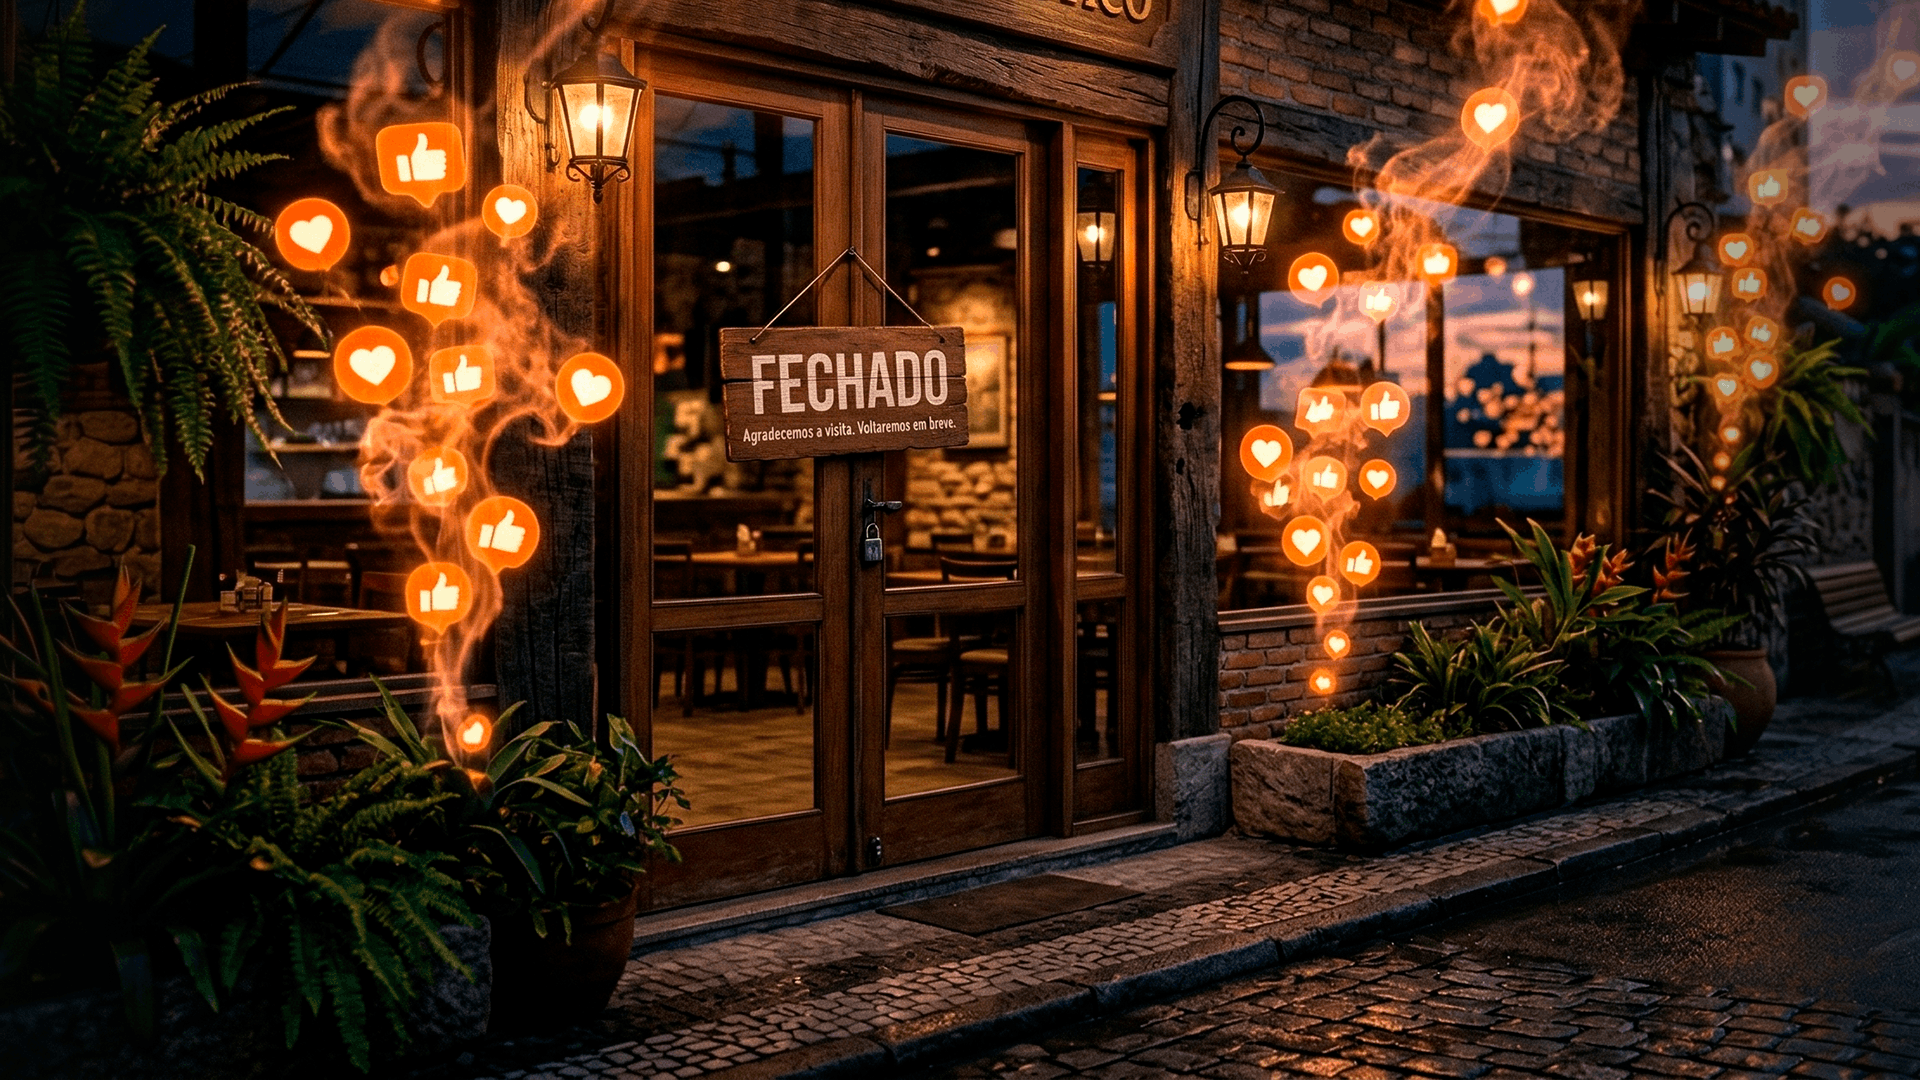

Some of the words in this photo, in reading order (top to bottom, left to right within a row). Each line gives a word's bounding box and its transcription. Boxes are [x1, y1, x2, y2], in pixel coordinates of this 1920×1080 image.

[751, 349, 948, 415] FECHADO
[743, 426, 814, 446] Agradecemos
[816, 427, 823, 438] a
[825, 422, 855, 437] visita.
[857, 420, 911, 434] Voltaremos
[913, 420, 927, 431] em
[929, 416, 957, 430] breve.
